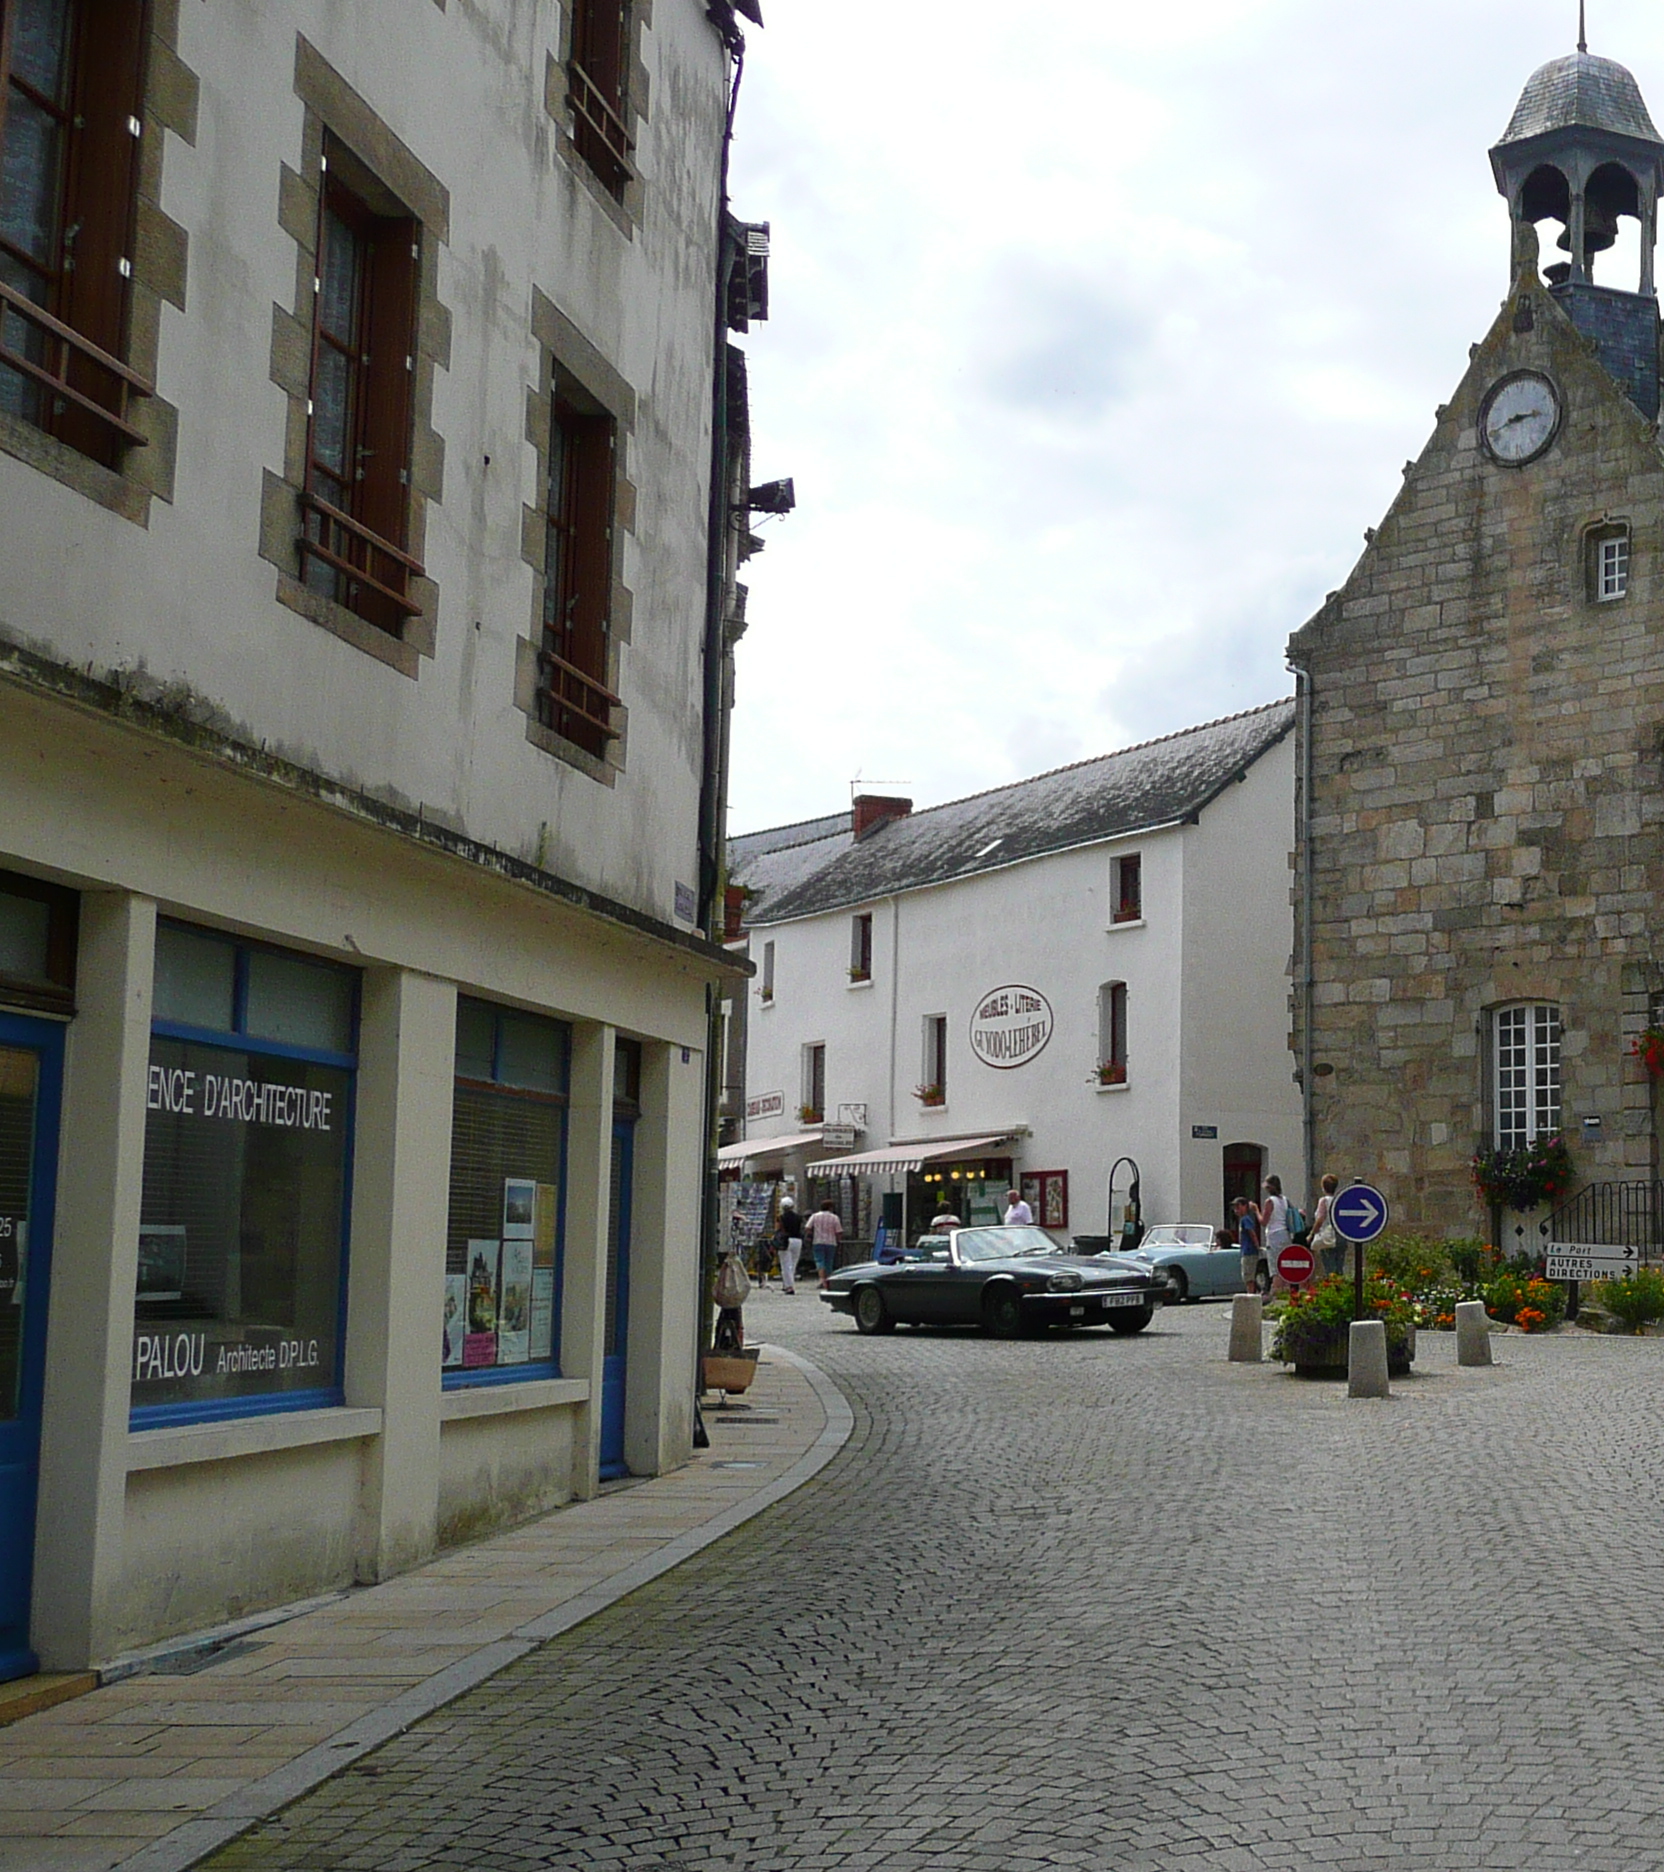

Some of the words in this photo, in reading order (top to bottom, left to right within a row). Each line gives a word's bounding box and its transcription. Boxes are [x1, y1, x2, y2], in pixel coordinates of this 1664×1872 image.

[979, 994, 1009, 1020] MEUBLES
[1015, 993, 1042, 1014] LITERIE
[203, 1074, 333, 1131] D'ARCHITECTURE
[1550, 1244, 1562, 1254] Le
[1569, 1245, 1592, 1255] Port
[1549, 1258, 1593, 1269] AUTRES
[1549, 1268, 1616, 1280] DIRECTIONS
[136, 1333, 205, 1380] PALOU
[216, 1344, 276, 1373] Architecte
[279, 1339, 320, 1368] D.P.L.G.
